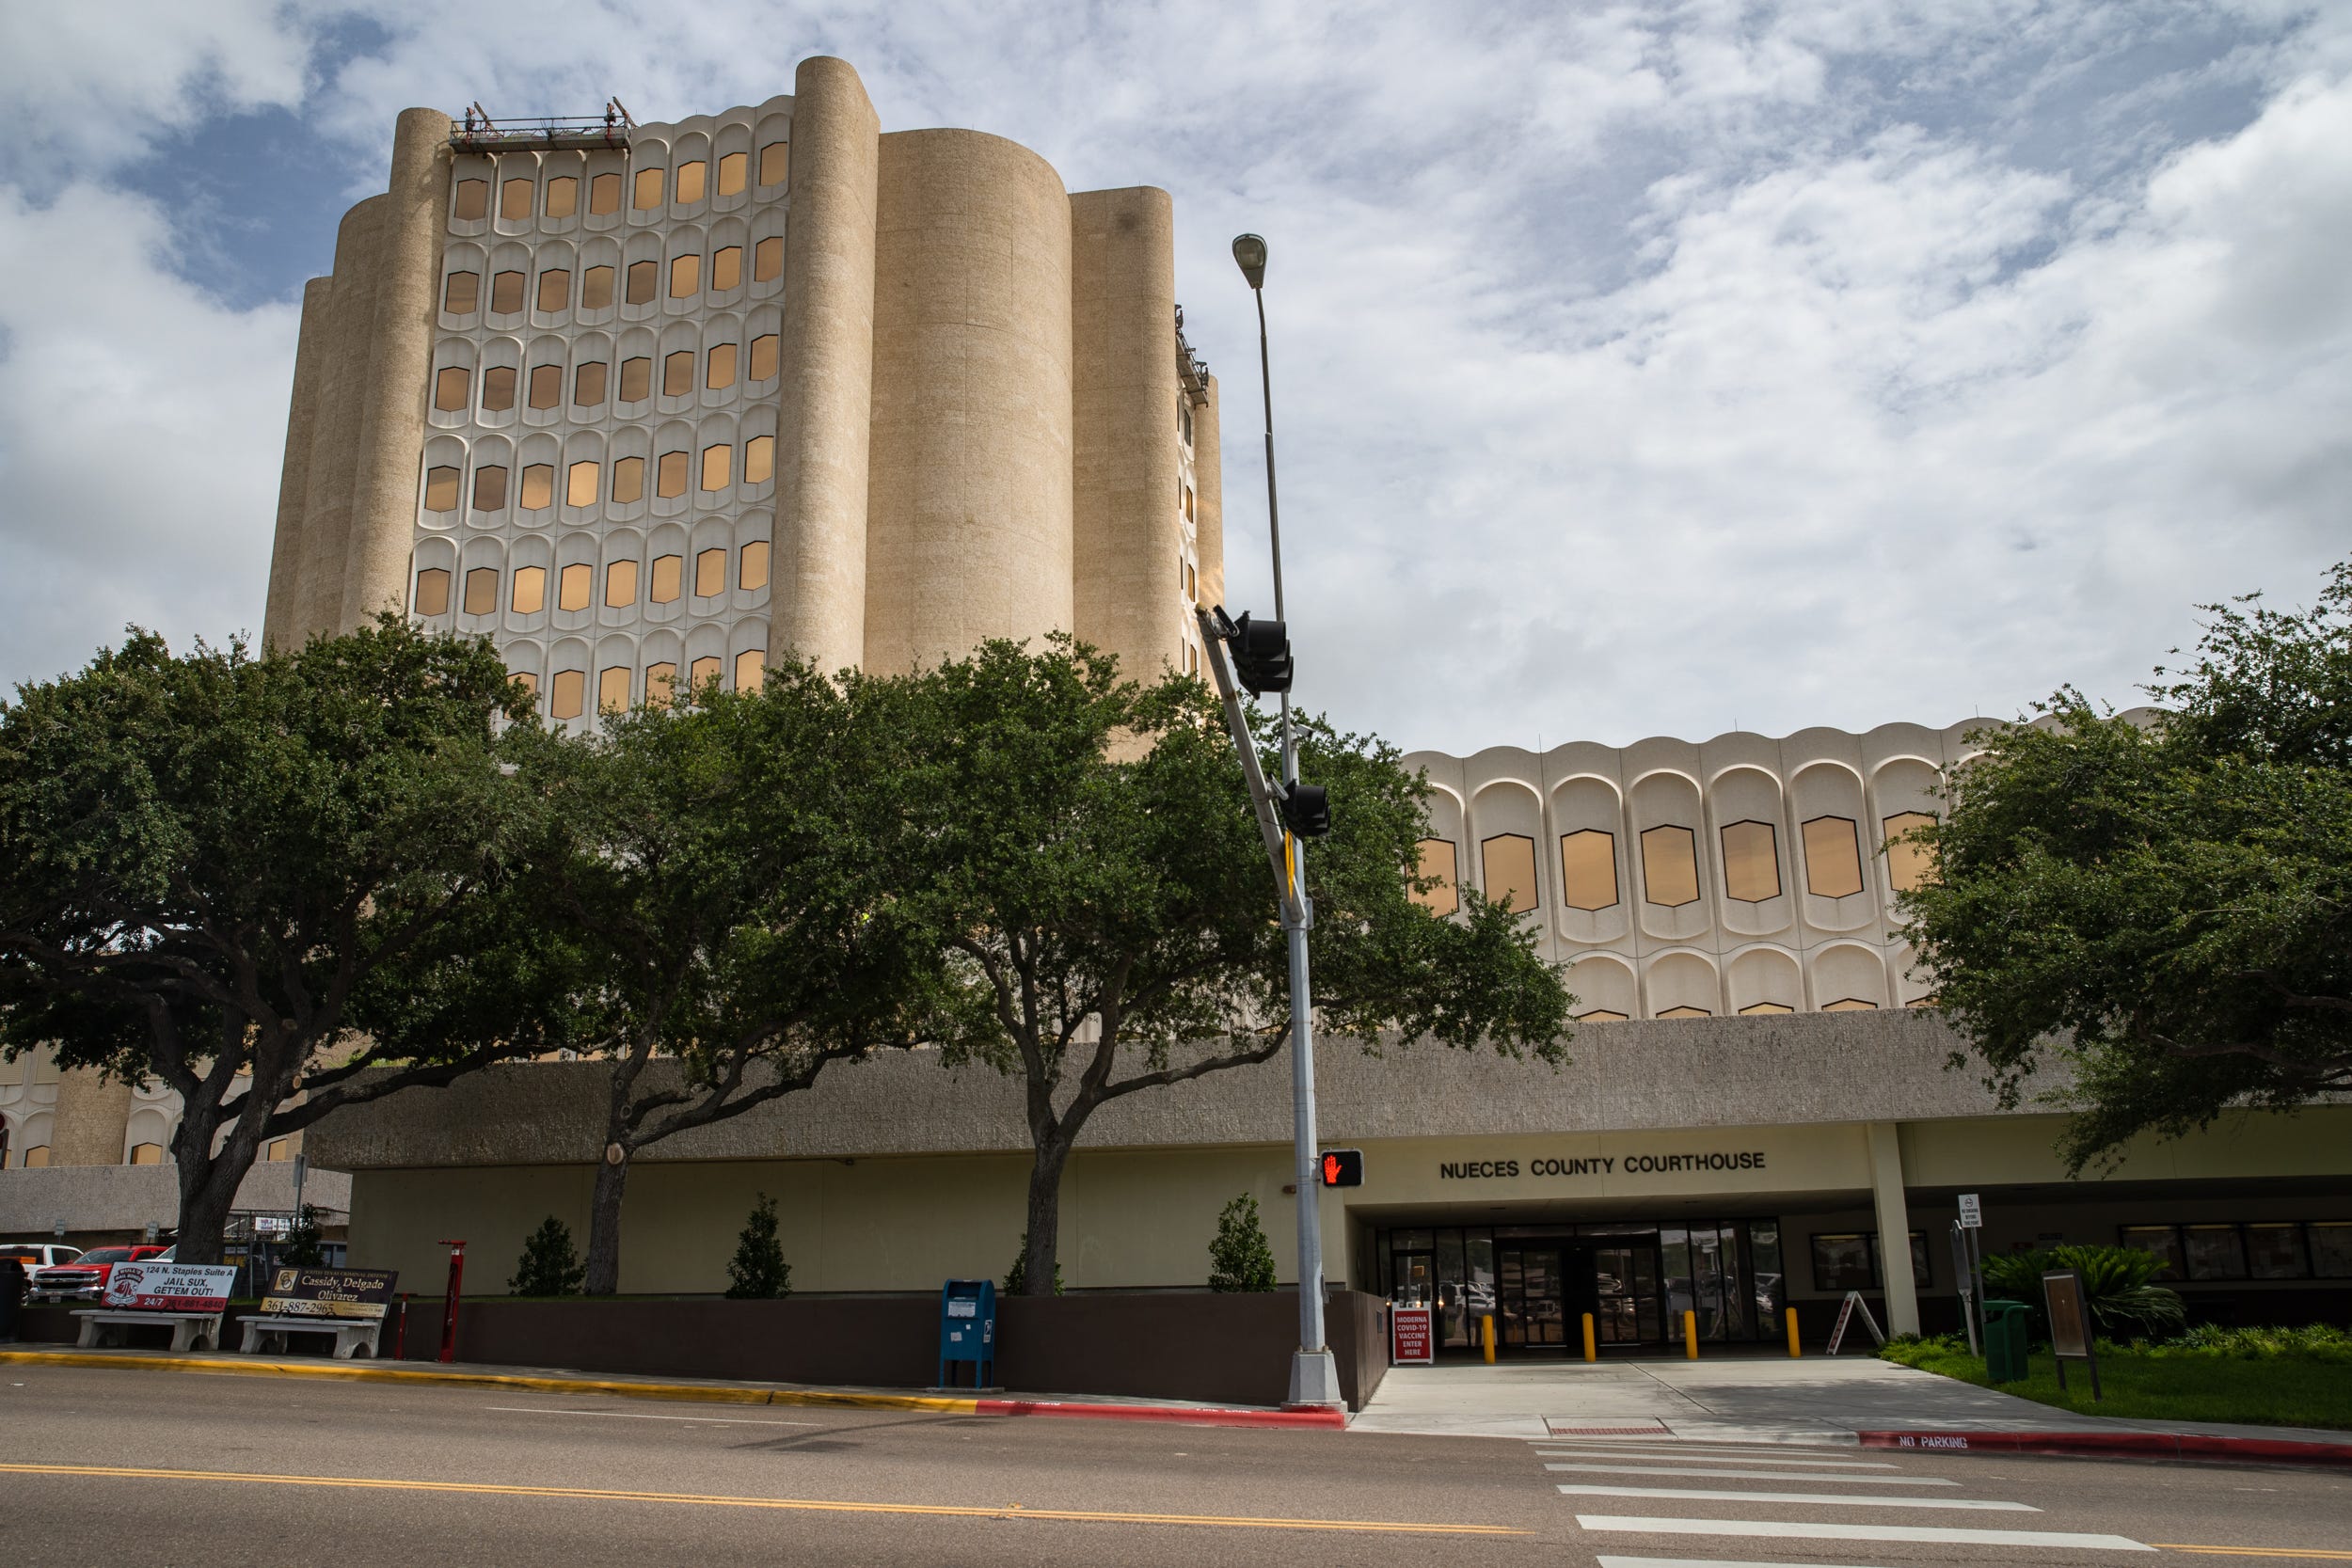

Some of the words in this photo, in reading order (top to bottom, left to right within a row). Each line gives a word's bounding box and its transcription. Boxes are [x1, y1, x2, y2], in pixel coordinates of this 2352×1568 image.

[1439, 1161, 1519, 1180] NUECES
[1530, 1158, 1615, 1177] COUNTY
[1624, 1152, 1766, 1174] COURTHOUSE
[146, 1266, 160, 1275] 124
[172, 1266, 202, 1277] Staples
[204, 1267, 226, 1276] Suite
[226, 1269, 233, 1277] A
[164, 1277, 184, 1287] JAIL
[187, 1277, 209, 1288] SUX,
[301, 1275, 341, 1289] Cassidy,
[342, 1277, 385, 1291] Delgado
[153, 1286, 189, 1296] GET'EM
[191, 1287, 215, 1296] OUT!
[317, 1290, 359, 1302] Olivarez
[144, 1297, 164, 1306] 24/7
[265, 1300, 335, 1314] 361-887-2965
[1899, 1435, 1915, 1448] NO
[1920, 1436, 1968, 1449] PARKING
